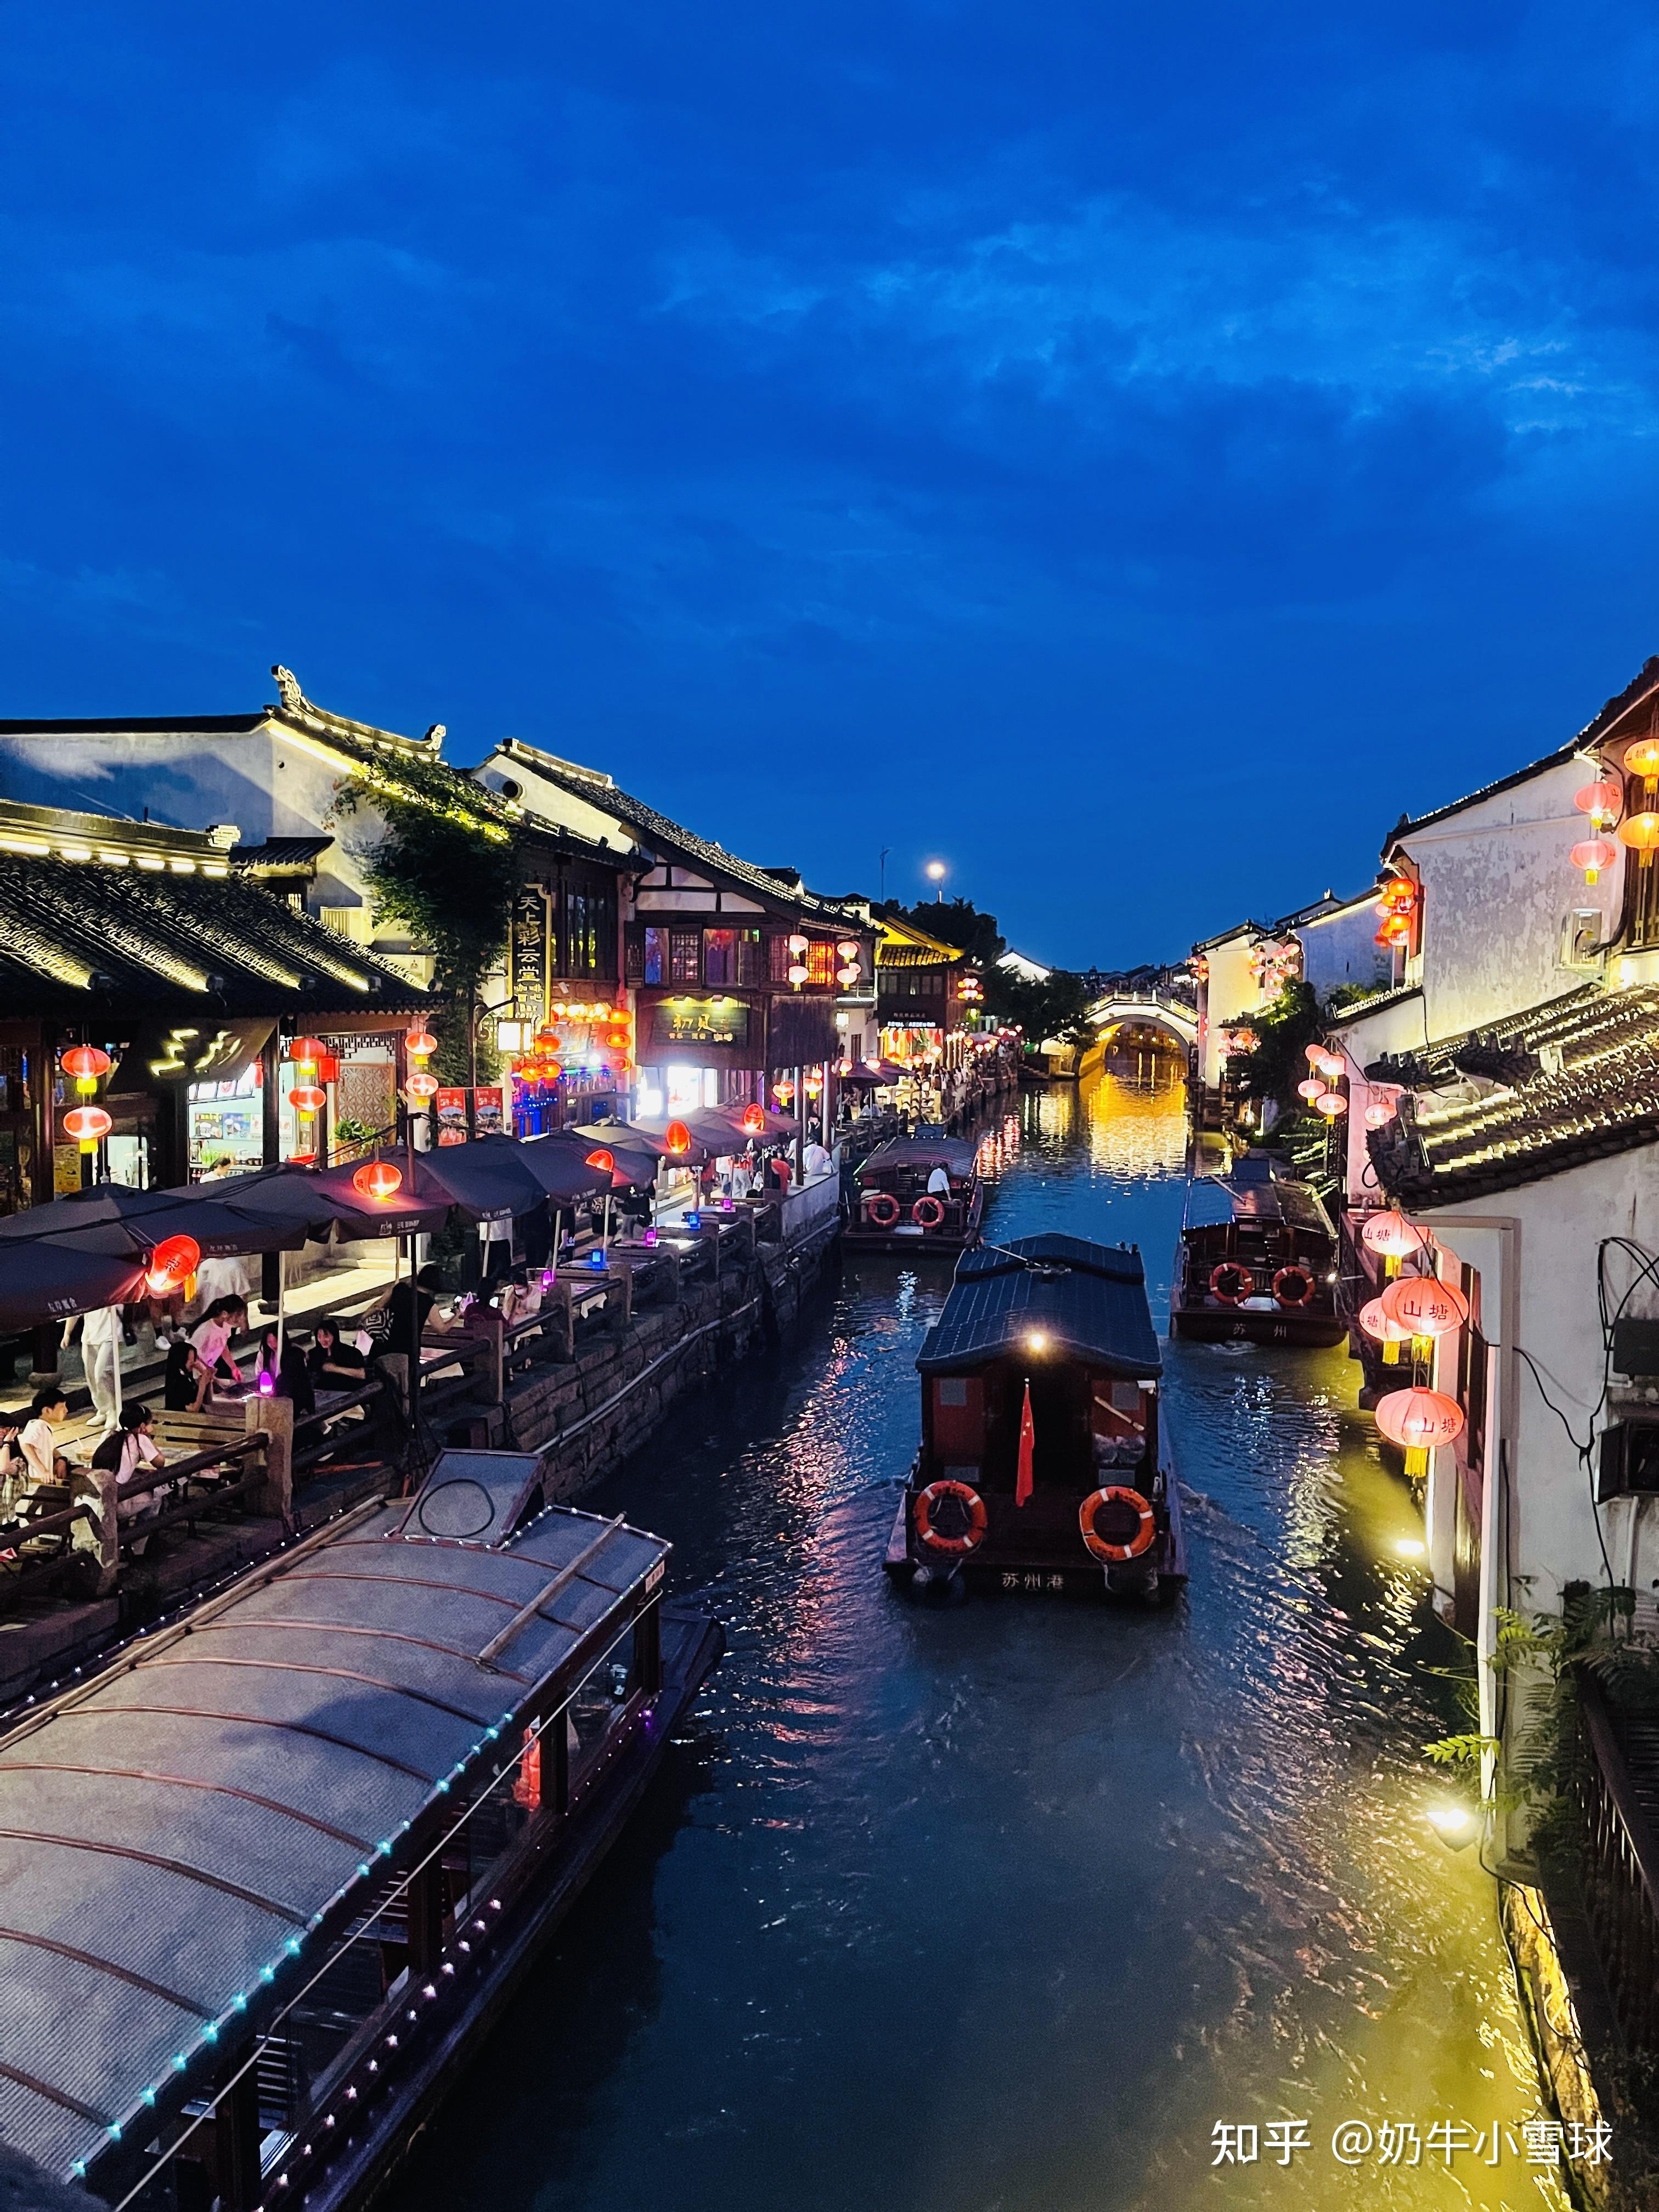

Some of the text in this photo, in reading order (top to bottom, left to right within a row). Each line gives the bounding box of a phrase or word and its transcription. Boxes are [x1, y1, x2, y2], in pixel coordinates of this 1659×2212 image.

[517, 896, 541, 982] 天上彩云堂
[520, 1003, 538, 1012] Bar
[1364, 1227, 1390, 1242] 山塘
[1403, 1300, 1449, 1320] 山塘
[1415, 1417, 1457, 1434] 山塘
[1001, 1572, 1064, 1590] 苏州港
